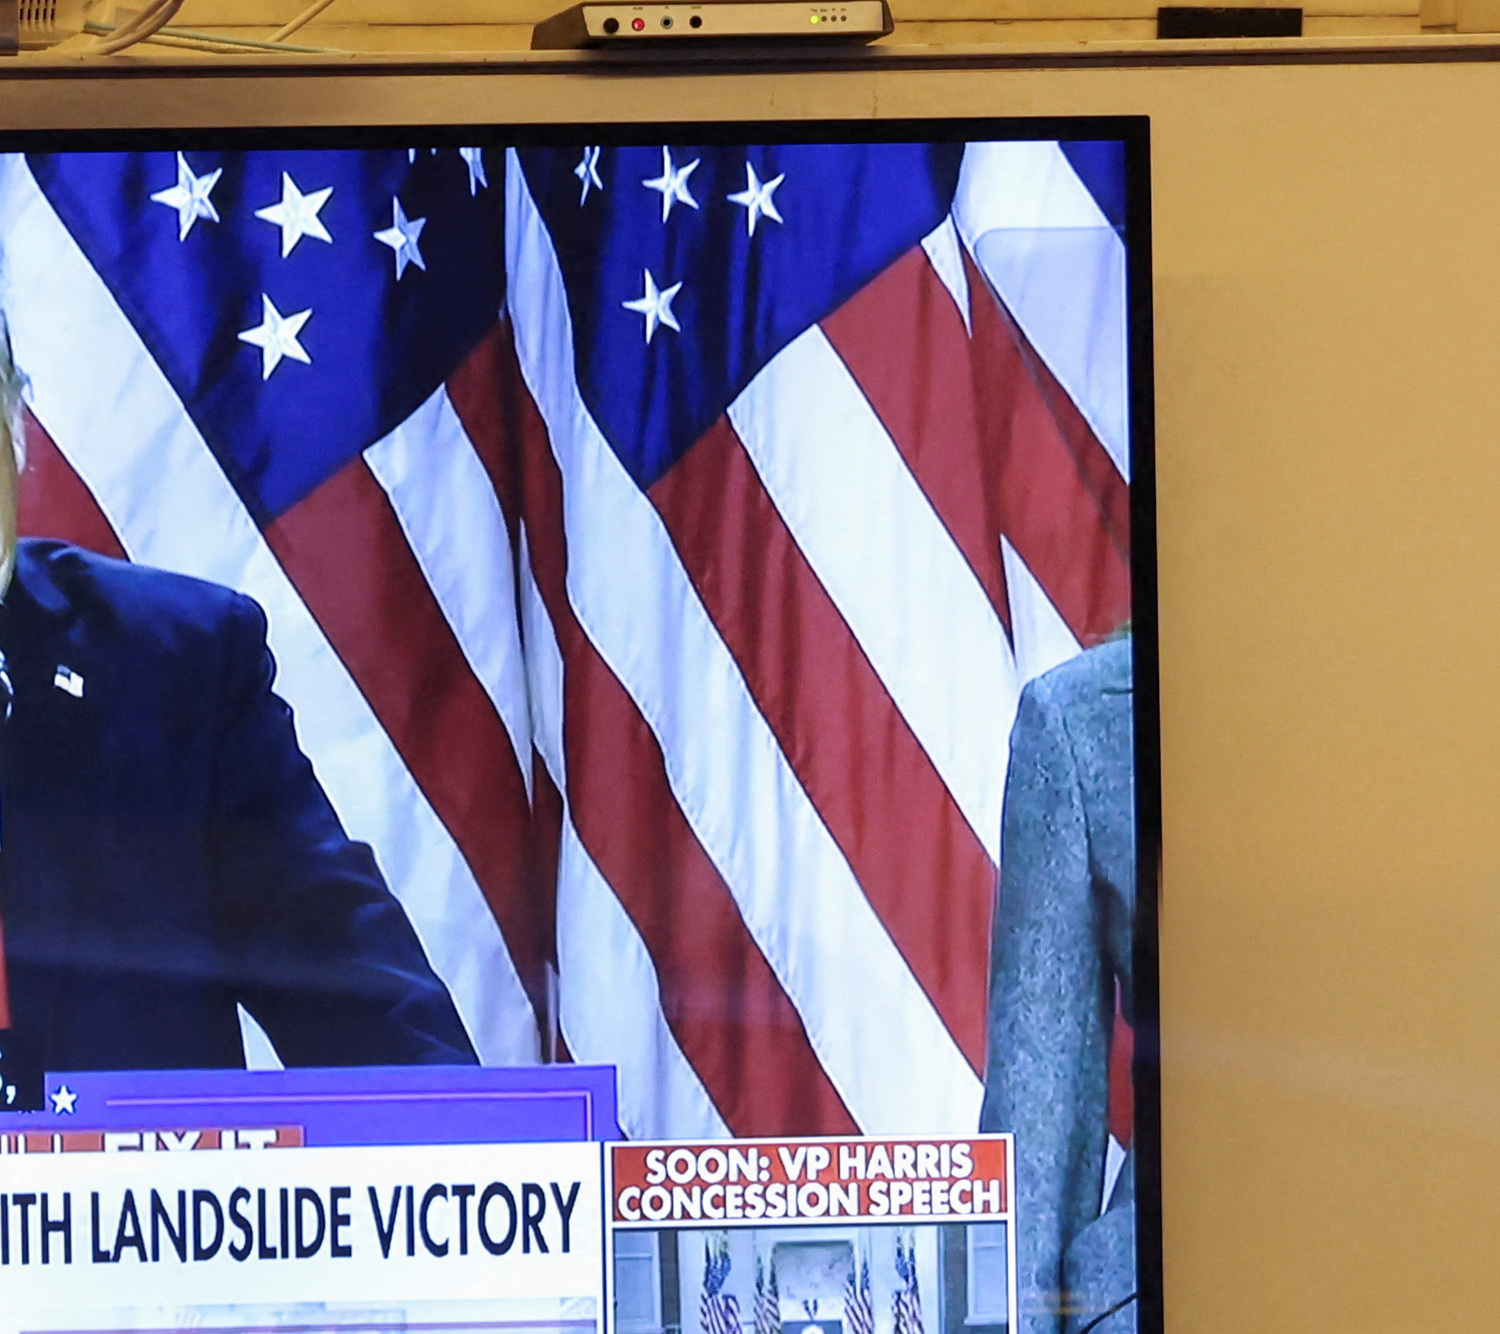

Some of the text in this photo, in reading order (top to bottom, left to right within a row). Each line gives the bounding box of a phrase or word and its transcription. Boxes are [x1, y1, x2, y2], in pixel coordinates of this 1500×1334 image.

[646, 1143, 974, 1185] SOON: VP HARRIS
[618, 1179, 1001, 1220] CONCESSION SPEECH
[91, 1186, 353, 1263] LANDSLIDE
[367, 1181, 582, 1259] VICTORY
